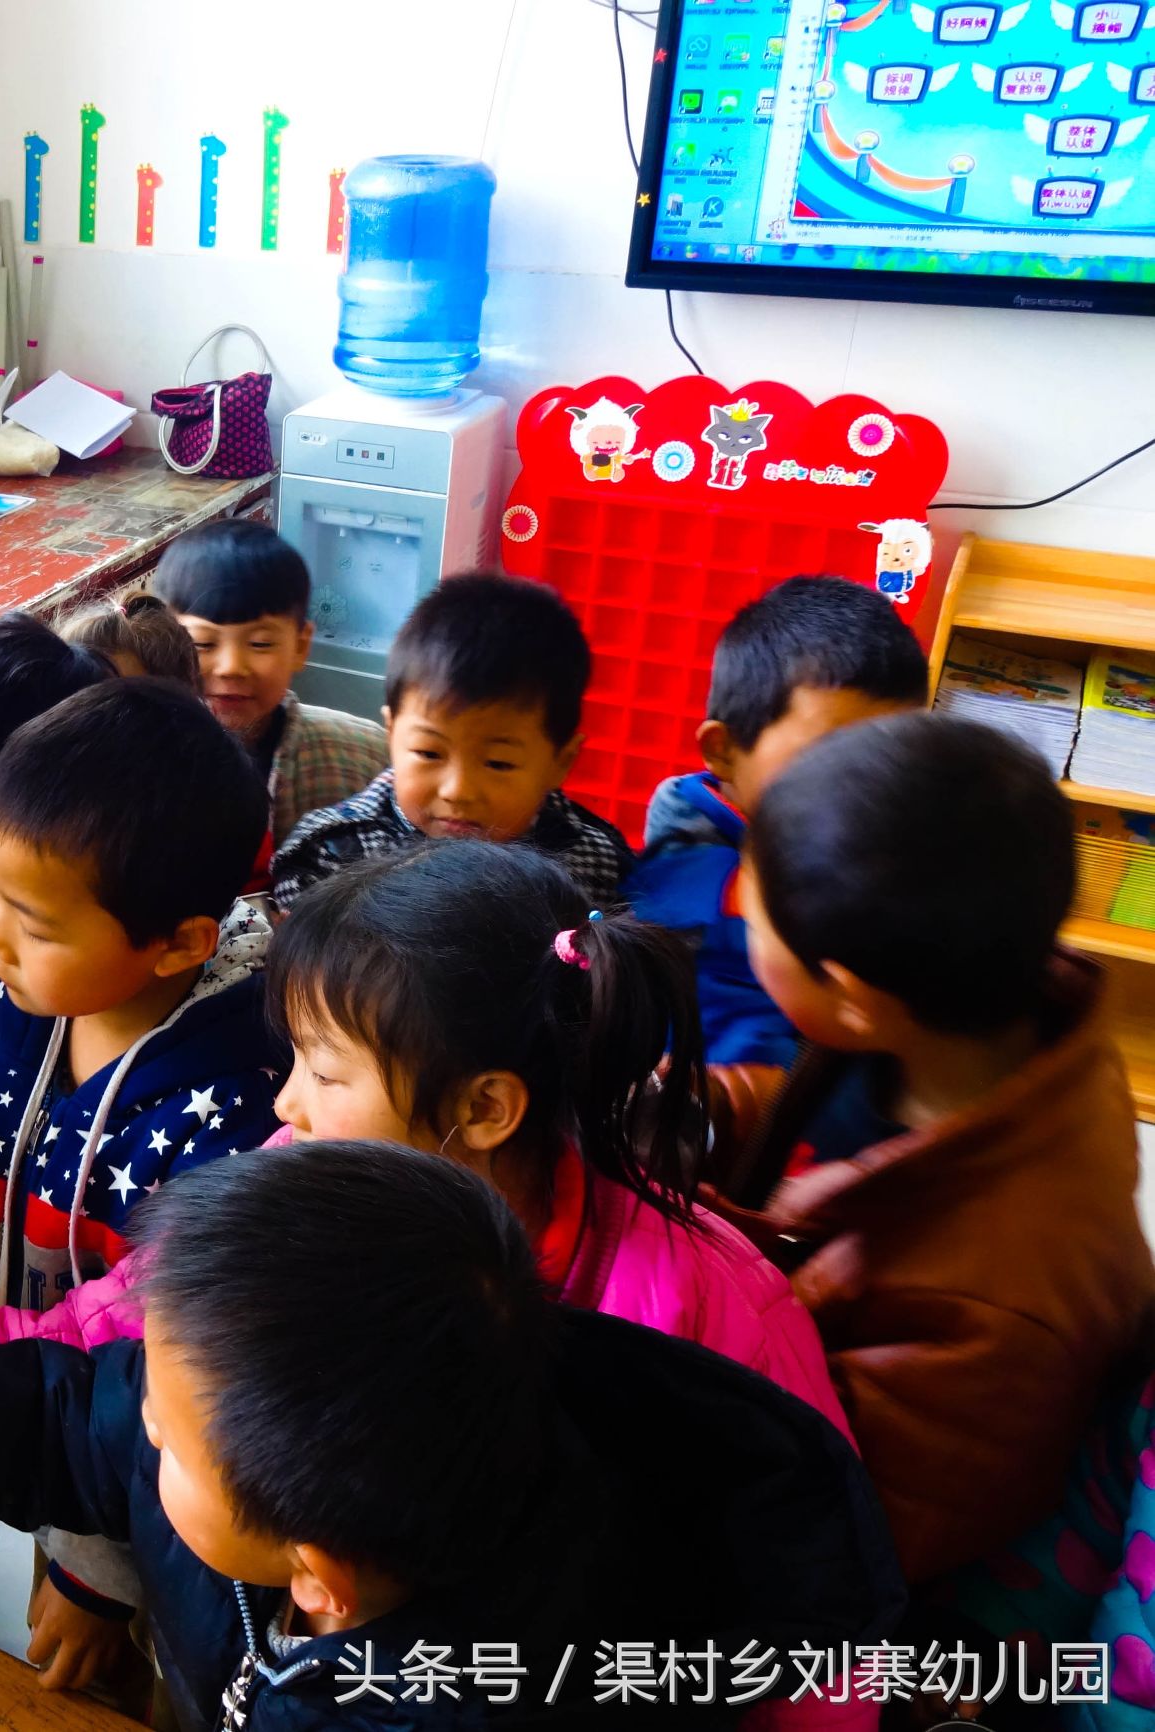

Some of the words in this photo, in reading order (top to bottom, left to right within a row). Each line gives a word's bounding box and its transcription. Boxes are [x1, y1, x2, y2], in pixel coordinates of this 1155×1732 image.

[946, 17, 988, 29] 好阿姨
[886, 72, 914, 84] 标调
[1015, 72, 1043, 83] 认识
[884, 85, 911, 96] 规律
[1004, 84, 1047, 95] 复韵母
[1068, 126, 1097, 136] 整体
[1067, 137, 1094, 149] 认读
[1041, 188, 1093, 199] 整体认读
